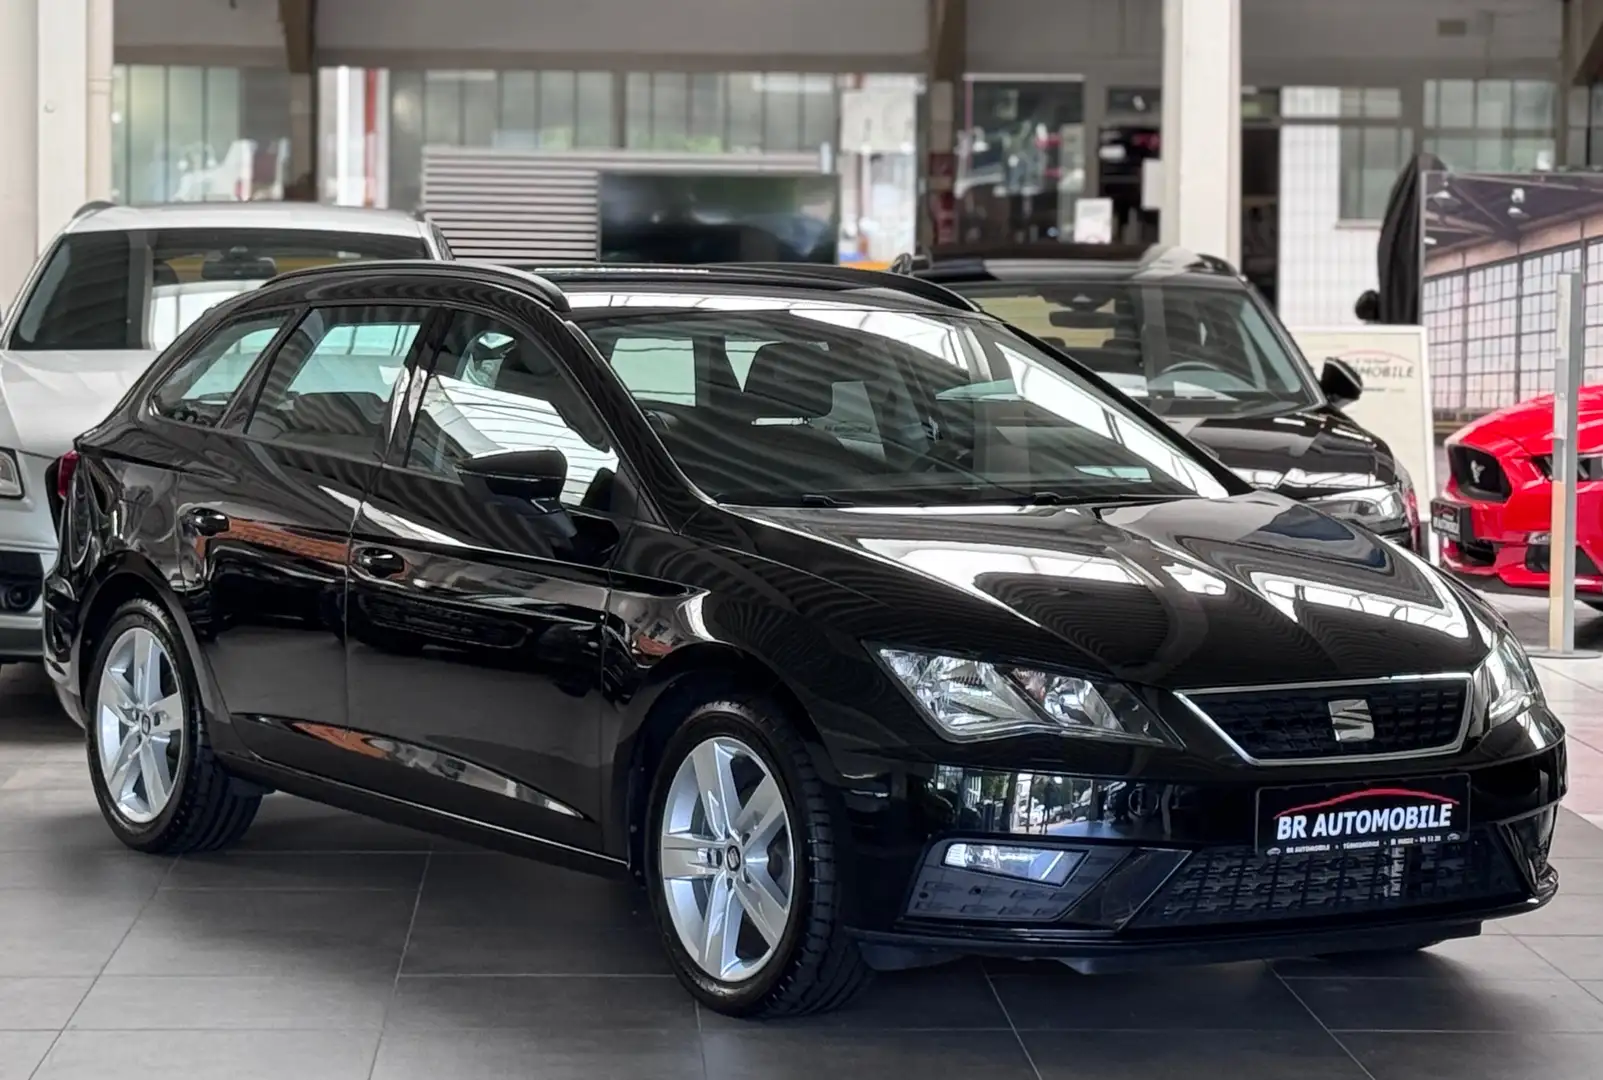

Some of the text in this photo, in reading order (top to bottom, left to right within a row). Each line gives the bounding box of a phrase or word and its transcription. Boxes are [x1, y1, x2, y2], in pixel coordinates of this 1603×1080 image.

[1355, 365, 1415, 379] MOBILE
[1277, 803, 1453, 840] BR AUTOMOBILE
